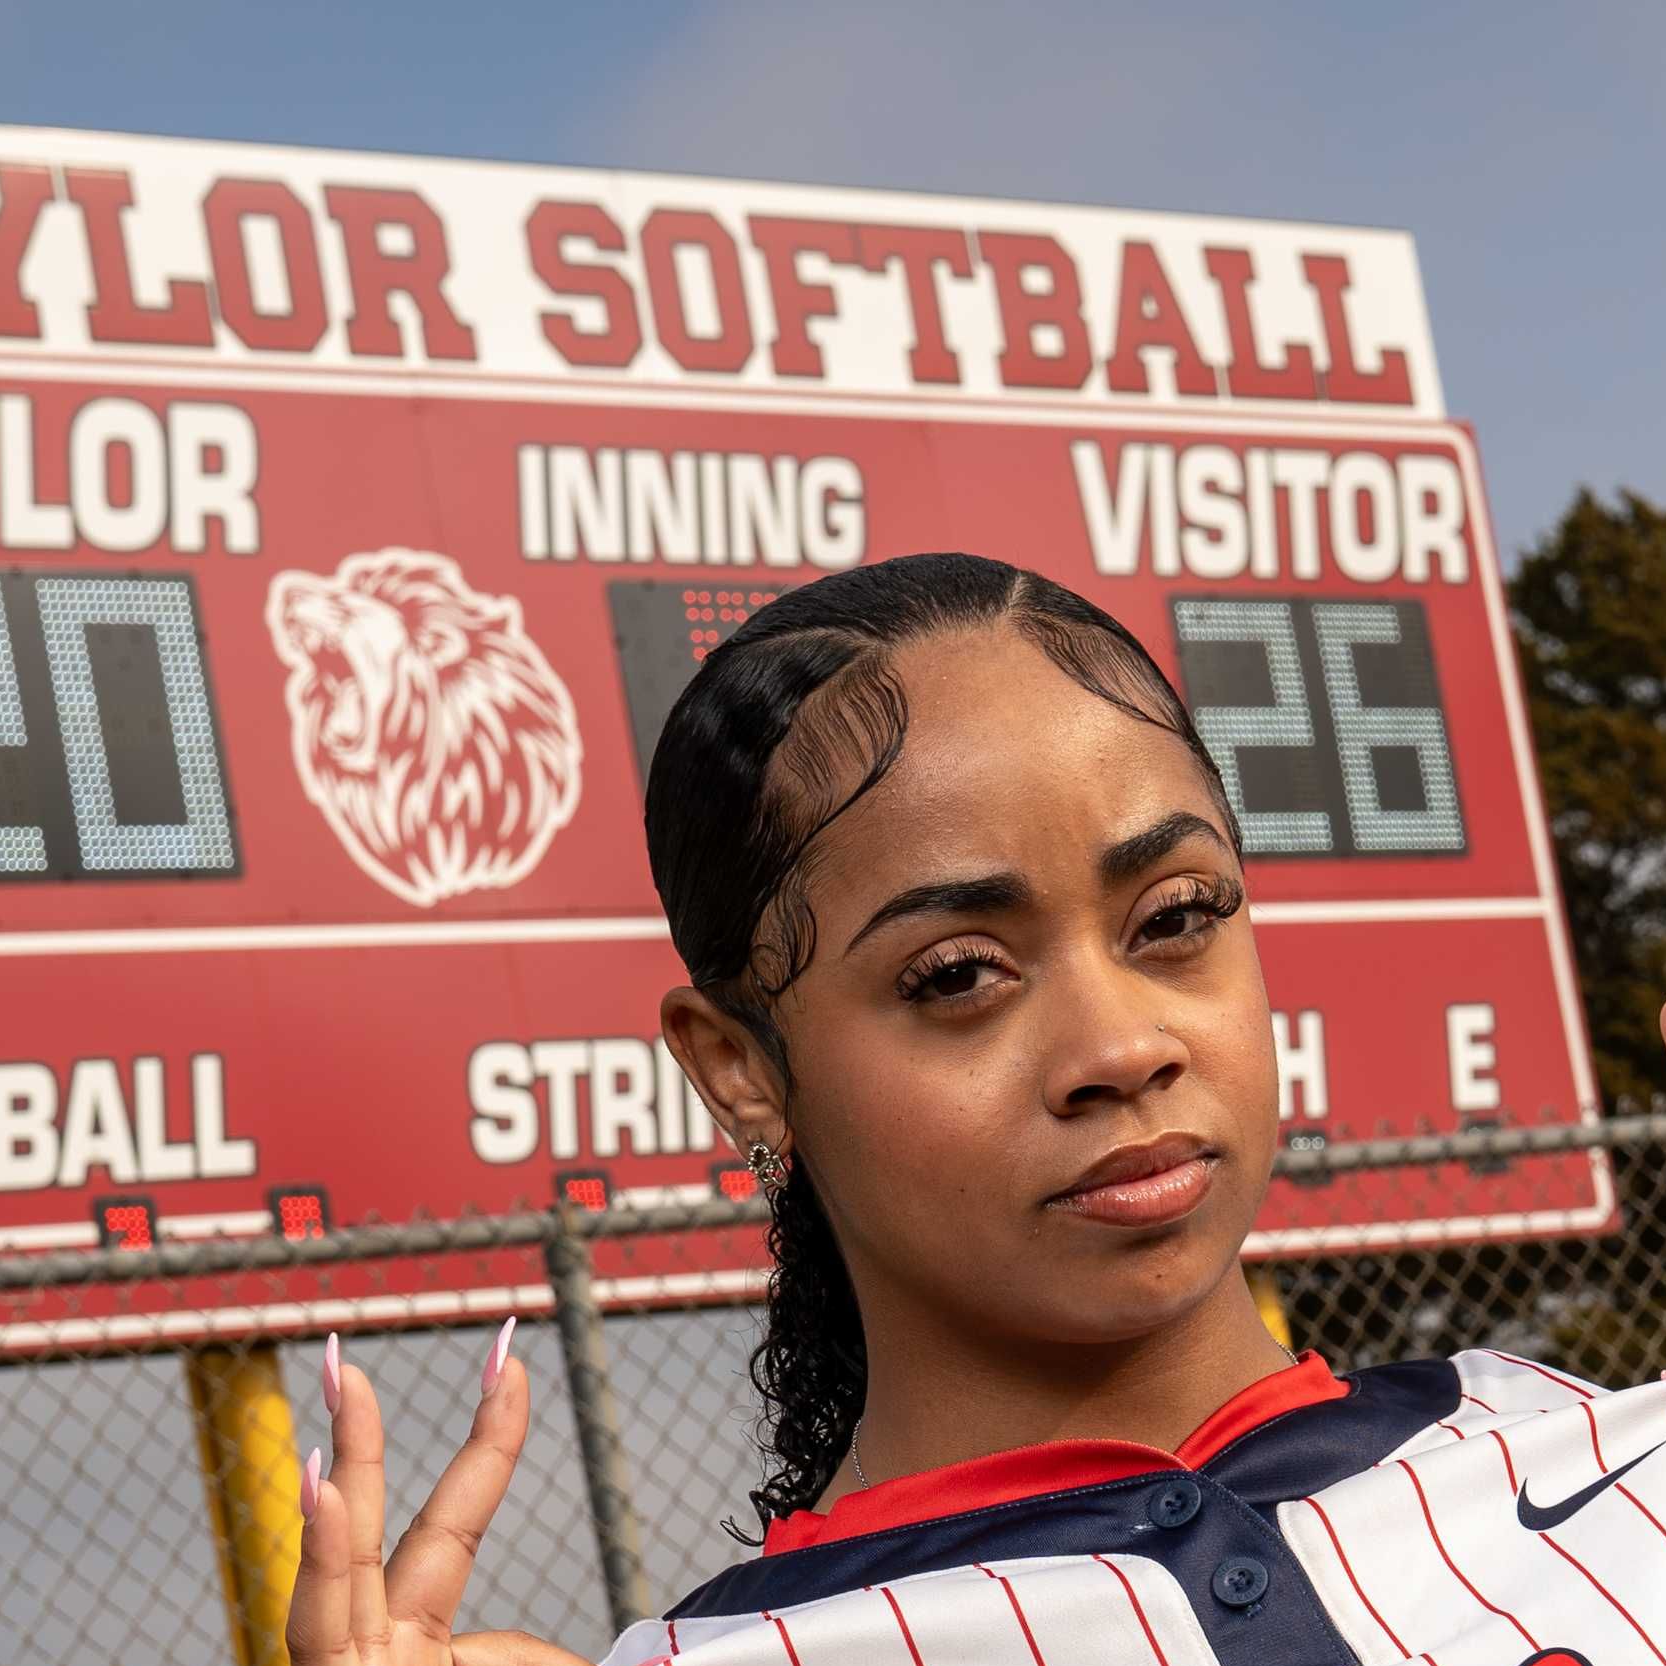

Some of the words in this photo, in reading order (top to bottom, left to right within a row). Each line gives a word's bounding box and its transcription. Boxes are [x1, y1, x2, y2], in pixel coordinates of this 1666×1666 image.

[525, 200, 1415, 408] SOFTBALL
[519, 443, 867, 570] INNING
[1070, 438, 1470, 586] VISITOR
[1174, 602, 1466, 852] 26
[1270, 1008, 1329, 1121] H
[1445, 1002, 1503, 1112] E
